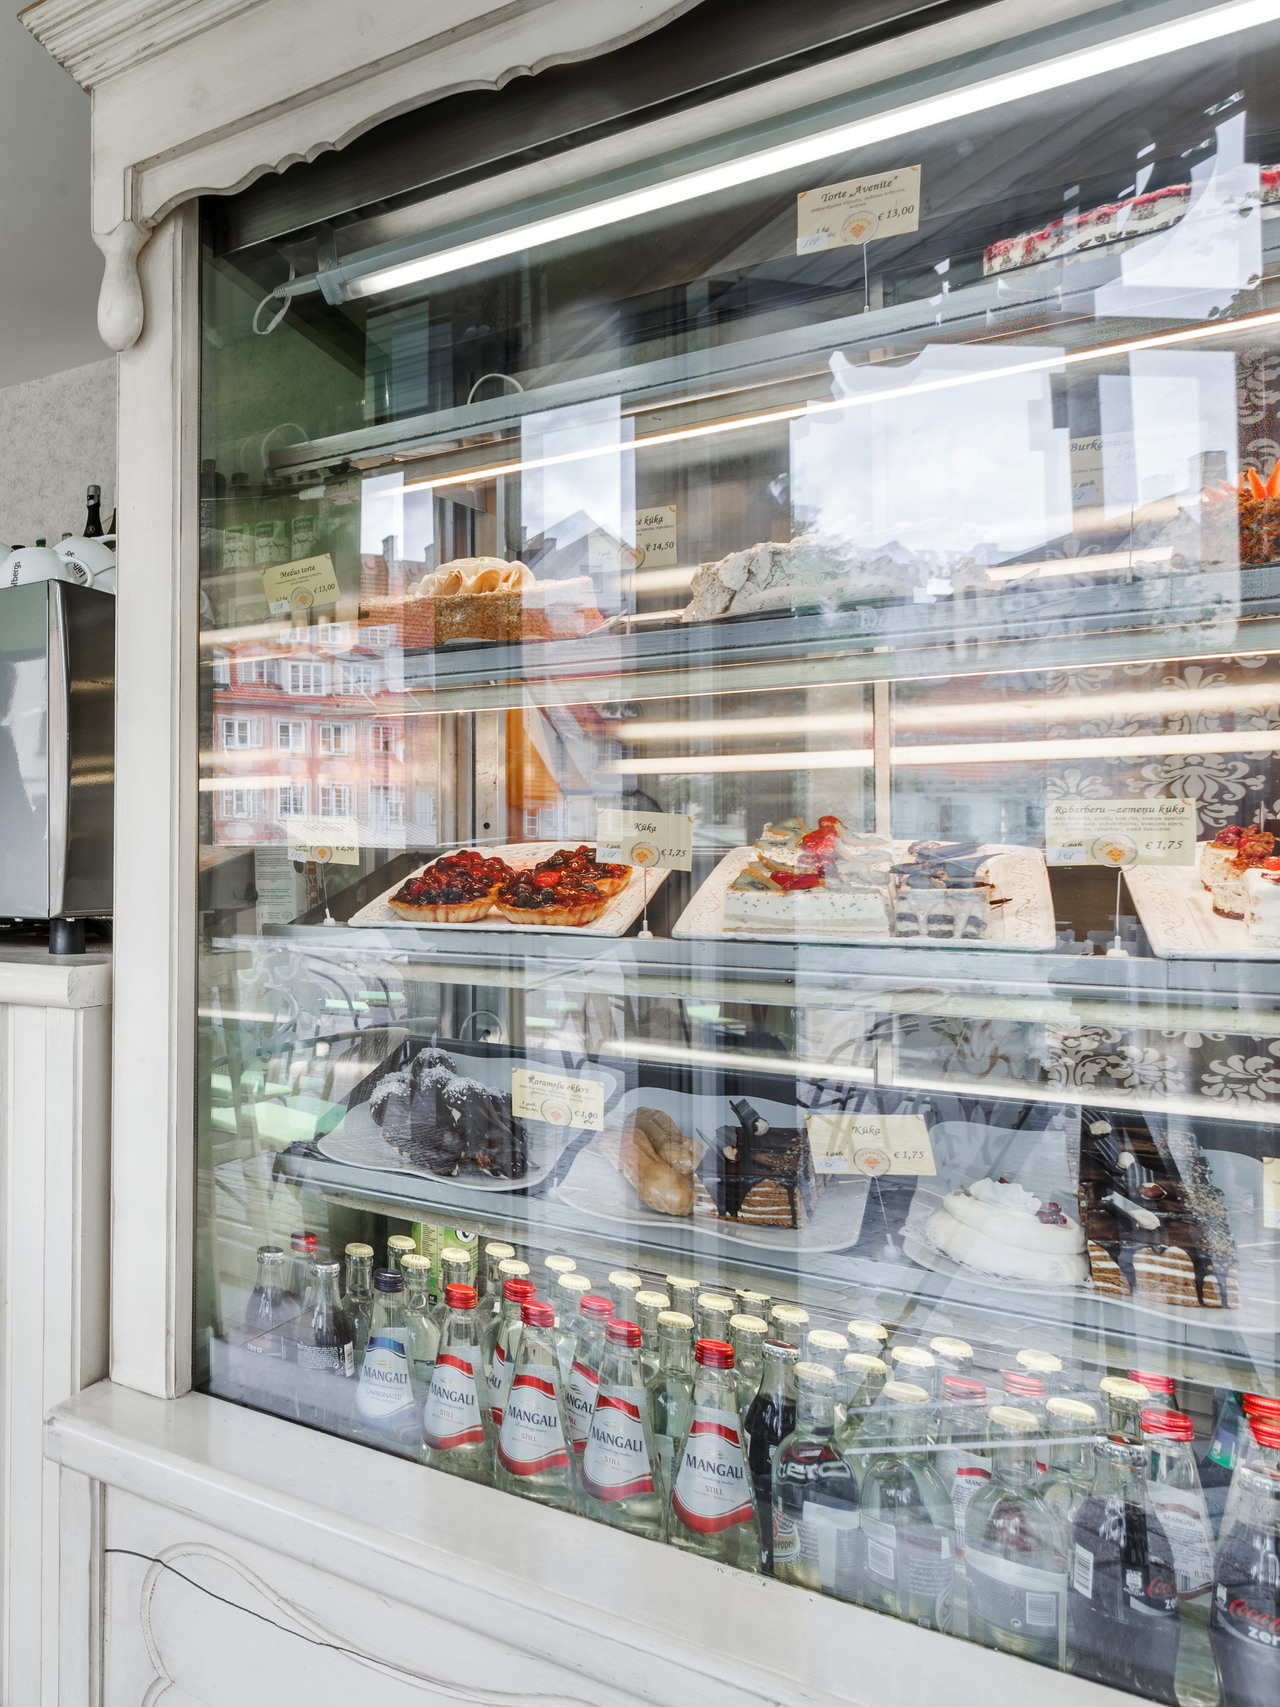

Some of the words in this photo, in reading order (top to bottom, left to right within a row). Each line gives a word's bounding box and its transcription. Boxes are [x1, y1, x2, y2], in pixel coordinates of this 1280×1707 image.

[821, 191, 847, 202] Torte
[878, 213, 884, 221] €
[886, 205, 915, 220] 13,00
[652, 541, 674, 551] 14,50
[280, 568, 300, 578] Medus
[301, 565, 316, 573] torte
[319, 583, 335, 593] 13,00
[1054, 805, 1106, 816] Rabarberu
[1158, 804, 1185, 814] kūka
[634, 822, 656, 833] Kūka
[1145, 841, 1153, 849] €
[1156, 840, 1183, 850] 1,75
[668, 849, 686, 857] 1,75
[852, 1126, 880, 1136] Kūka
[903, 1151, 924, 1160] 1,75
[364, 1366, 407, 1383] MANGALI
[366, 1388, 402, 1400] CARBONATED
[430, 1382, 474, 1405] MANGALI
[440, 1409, 455, 1418] STILL
[508, 1404, 557, 1427] MANGALI
[521, 1433, 536, 1441] STILL
[592, 1426, 643, 1452] MANGALI
[604, 1456, 621, 1466] STILL
[686, 1454, 744, 1479] MANGALI
[705, 1485, 723, 1496] STILL
[1163, 1514, 1195, 1527] MANGALI
